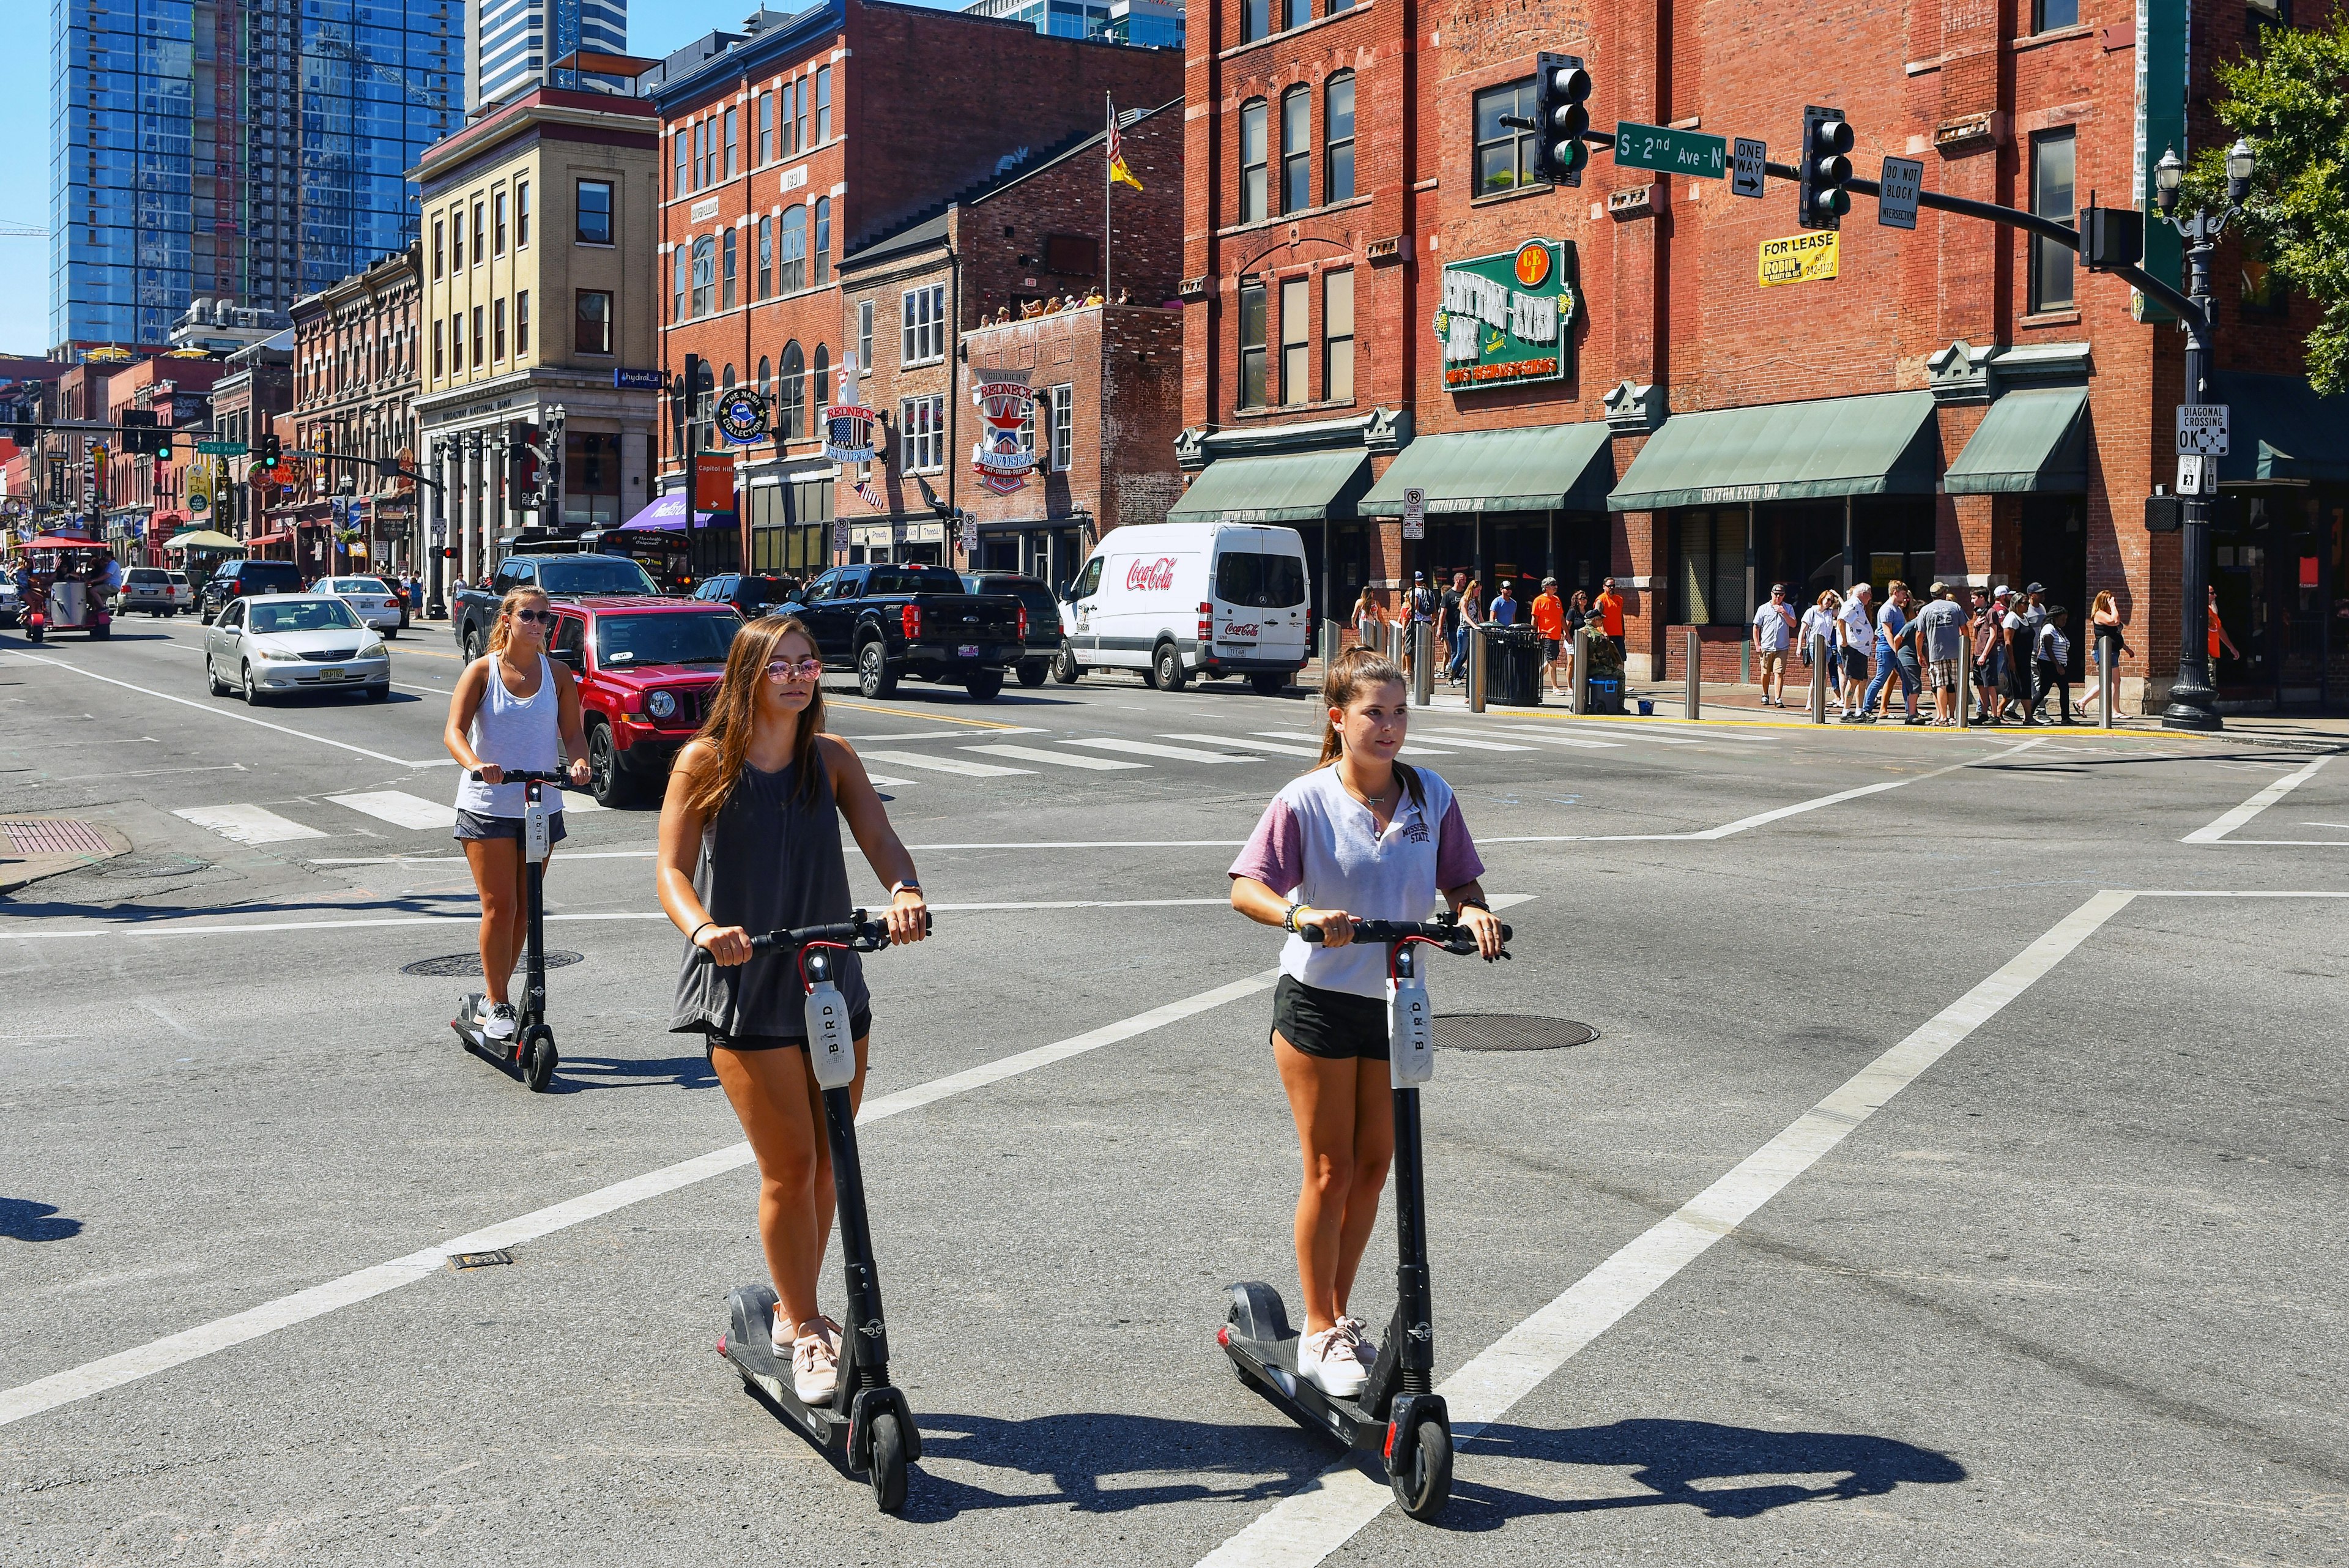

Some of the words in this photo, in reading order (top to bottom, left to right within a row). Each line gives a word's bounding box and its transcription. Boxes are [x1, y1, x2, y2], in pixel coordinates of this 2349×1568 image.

[1738, 143, 1762, 159] ONE
[1737, 159, 1762, 174] WAY
[1886, 165, 1897, 179] DO
[1902, 168, 1918, 182] NOT
[787, 171, 801, 188] 1891
[1887, 184, 1913, 200] BLOCK
[1881, 207, 1915, 222] INTERSECTION
[1764, 242, 1788, 256] FOR
[1792, 232, 1834, 251] LEASE
[1523, 249, 1541, 267] CE
[1814, 253, 1827, 262] (615)
[1527, 266, 1536, 281] J
[1764, 259, 1796, 275] ROBIN
[1806, 262, 1834, 275] 242-1122
[1769, 272, 1785, 280] REALTY
[725, 392, 740, 404] THE
[741, 392, 761, 406] NASH
[980, 383, 1034, 401] REDNECK
[442, 409, 467, 422] BROADWAY
[469, 403, 494, 415] NATIONAL
[497, 398, 512, 409] BANK
[827, 406, 875, 422] REDNECK
[2184, 407, 2223, 417] DIAGONAL
[722, 418, 763, 437] COLLECTION
[2184, 417, 2222, 426] CROSSING
[2180, 430, 2199, 448] OK
[828, 447, 875, 461] RIVIERA
[982, 450, 1034, 467] RIVIERA
[1702, 488, 1734, 502] COTTON
[1736, 486, 1759, 500] EYED
[1762, 484, 1779, 499] JOE
[1428, 499, 1453, 511] COTTON
[1453, 499, 1470, 511] EYED
[1471, 498, 1485, 510] JOE
[1222, 510, 1241, 521] COTTON
[1255, 510, 1266, 521] JOE
[872, 531, 888, 540] Proudly
[924, 527, 941, 536] Troops!
[1126, 557, 1178, 591] Coca-Cola
[1225, 622, 1260, 637] Coca-Cola
[1411, 832, 1430, 844] STATE
[823, 1006, 839, 1054] BIRD
[1412, 1002, 1424, 1050] BIRD
